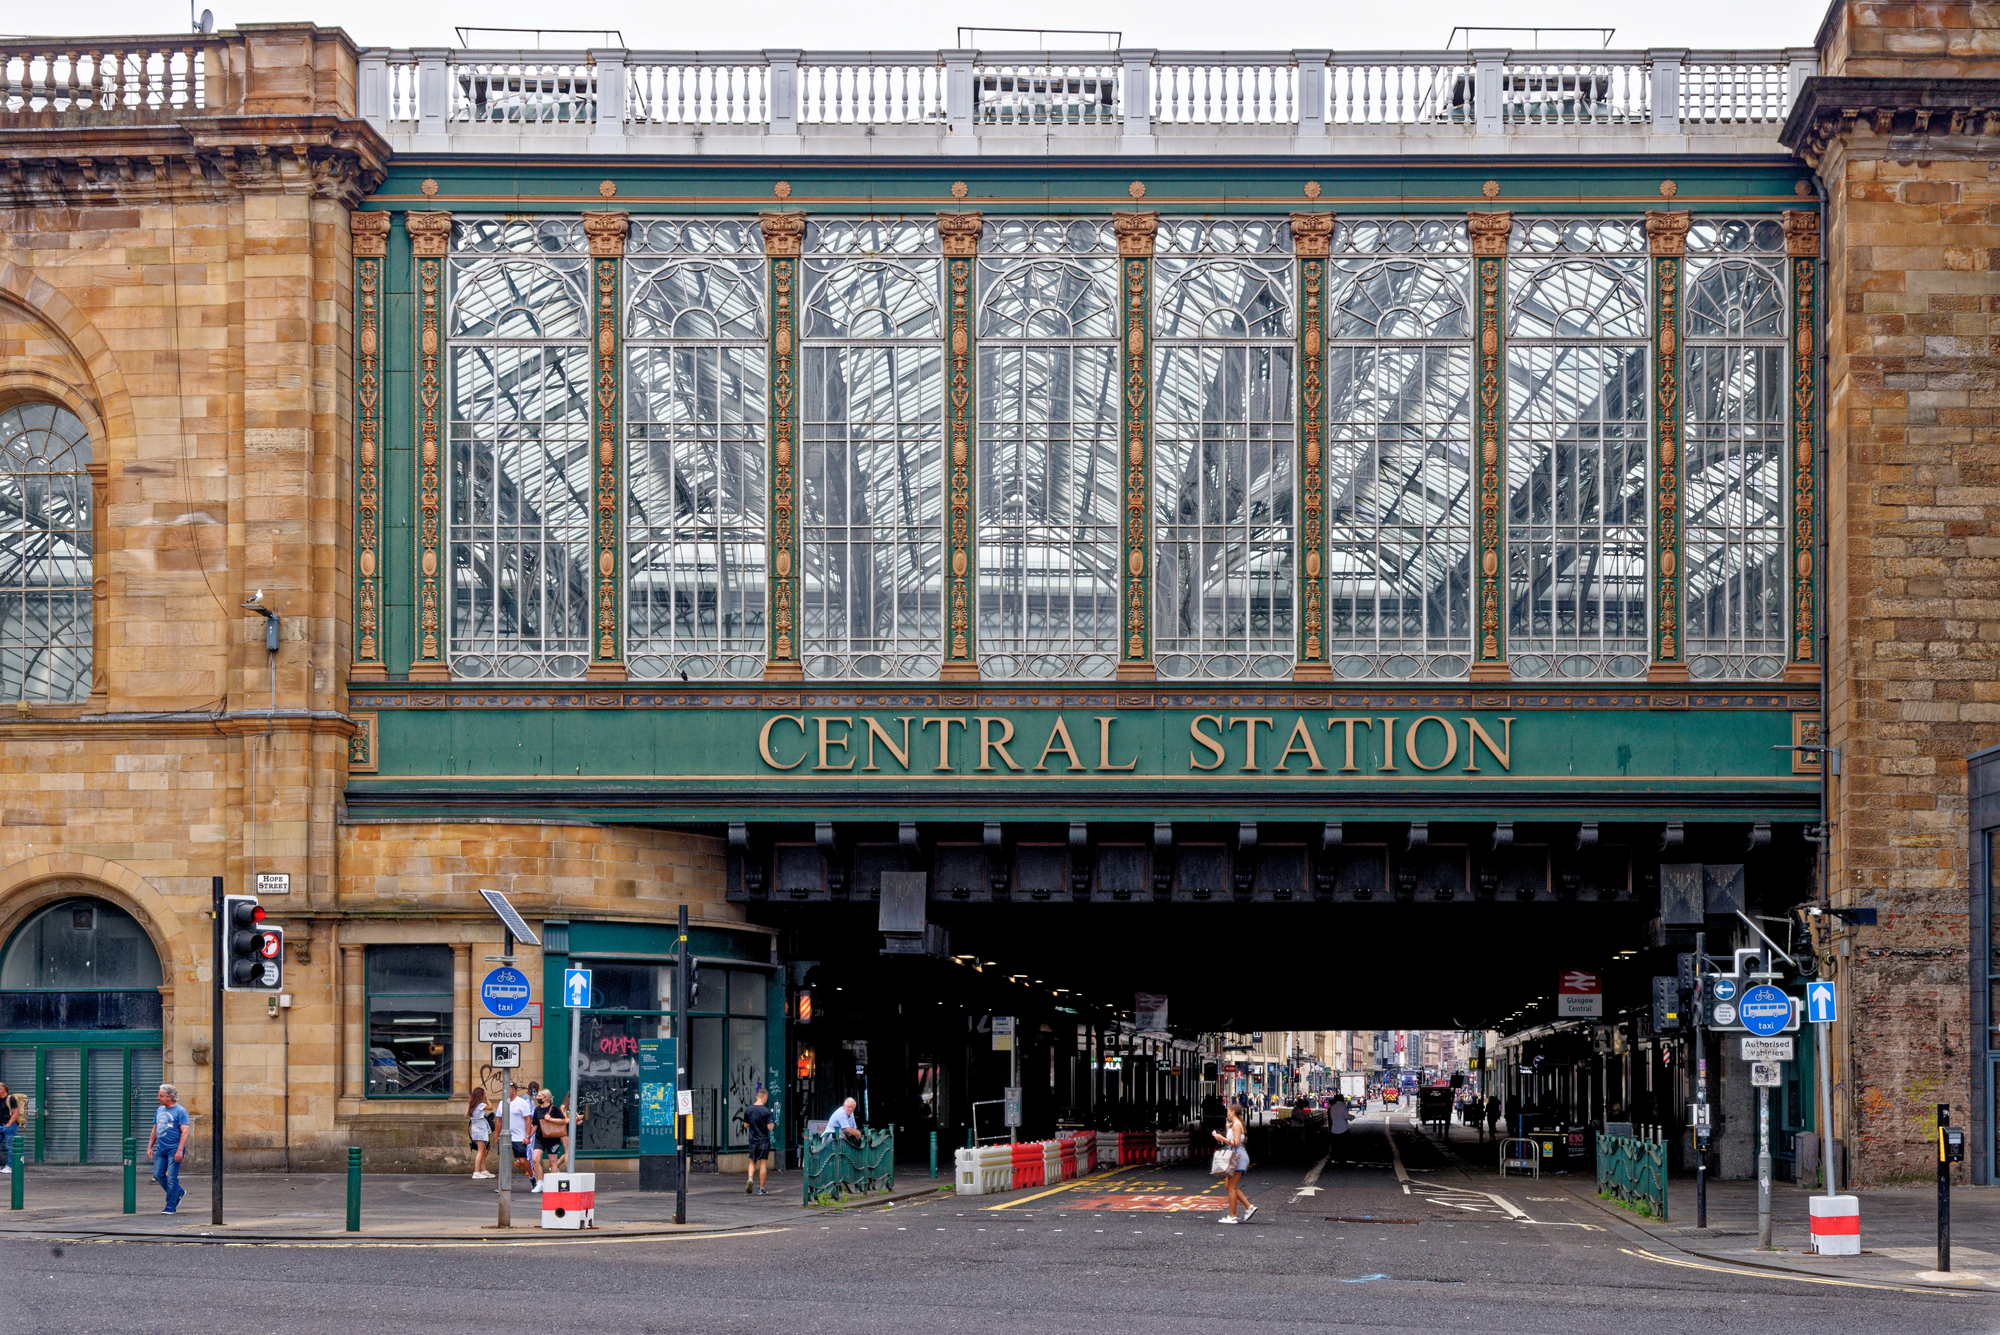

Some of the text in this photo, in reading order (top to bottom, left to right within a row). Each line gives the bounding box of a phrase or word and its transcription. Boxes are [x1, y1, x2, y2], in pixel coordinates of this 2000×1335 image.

[758, 714, 1517, 771] CENTRAL STATION
[1566, 997, 1594, 1005] Glasgow
[1758, 1022, 1774, 1030] taxi
